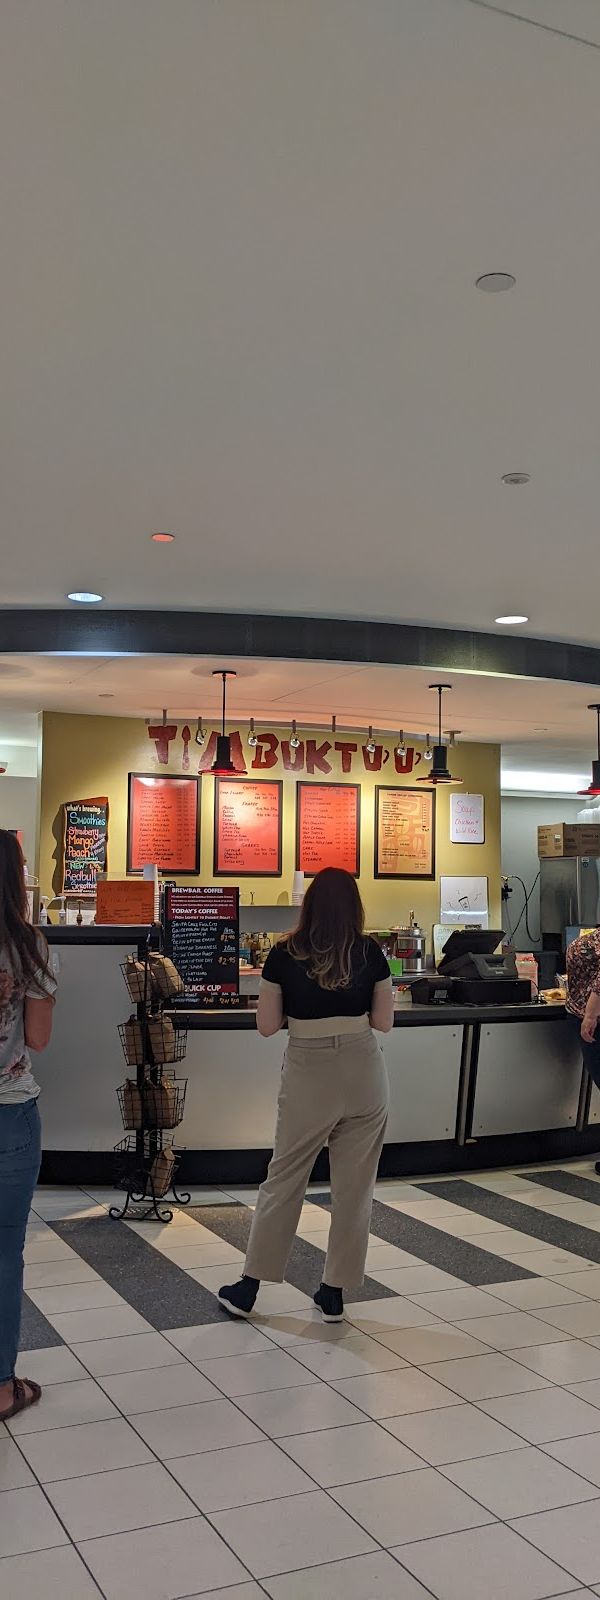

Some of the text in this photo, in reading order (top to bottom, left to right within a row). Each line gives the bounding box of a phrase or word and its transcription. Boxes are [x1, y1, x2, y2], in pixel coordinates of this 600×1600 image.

[69, 812, 106, 826] Smoothies
[68, 835, 94, 850] Mango
[68, 846, 90, 857] Peach
[66, 869, 97, 882] Redbull
